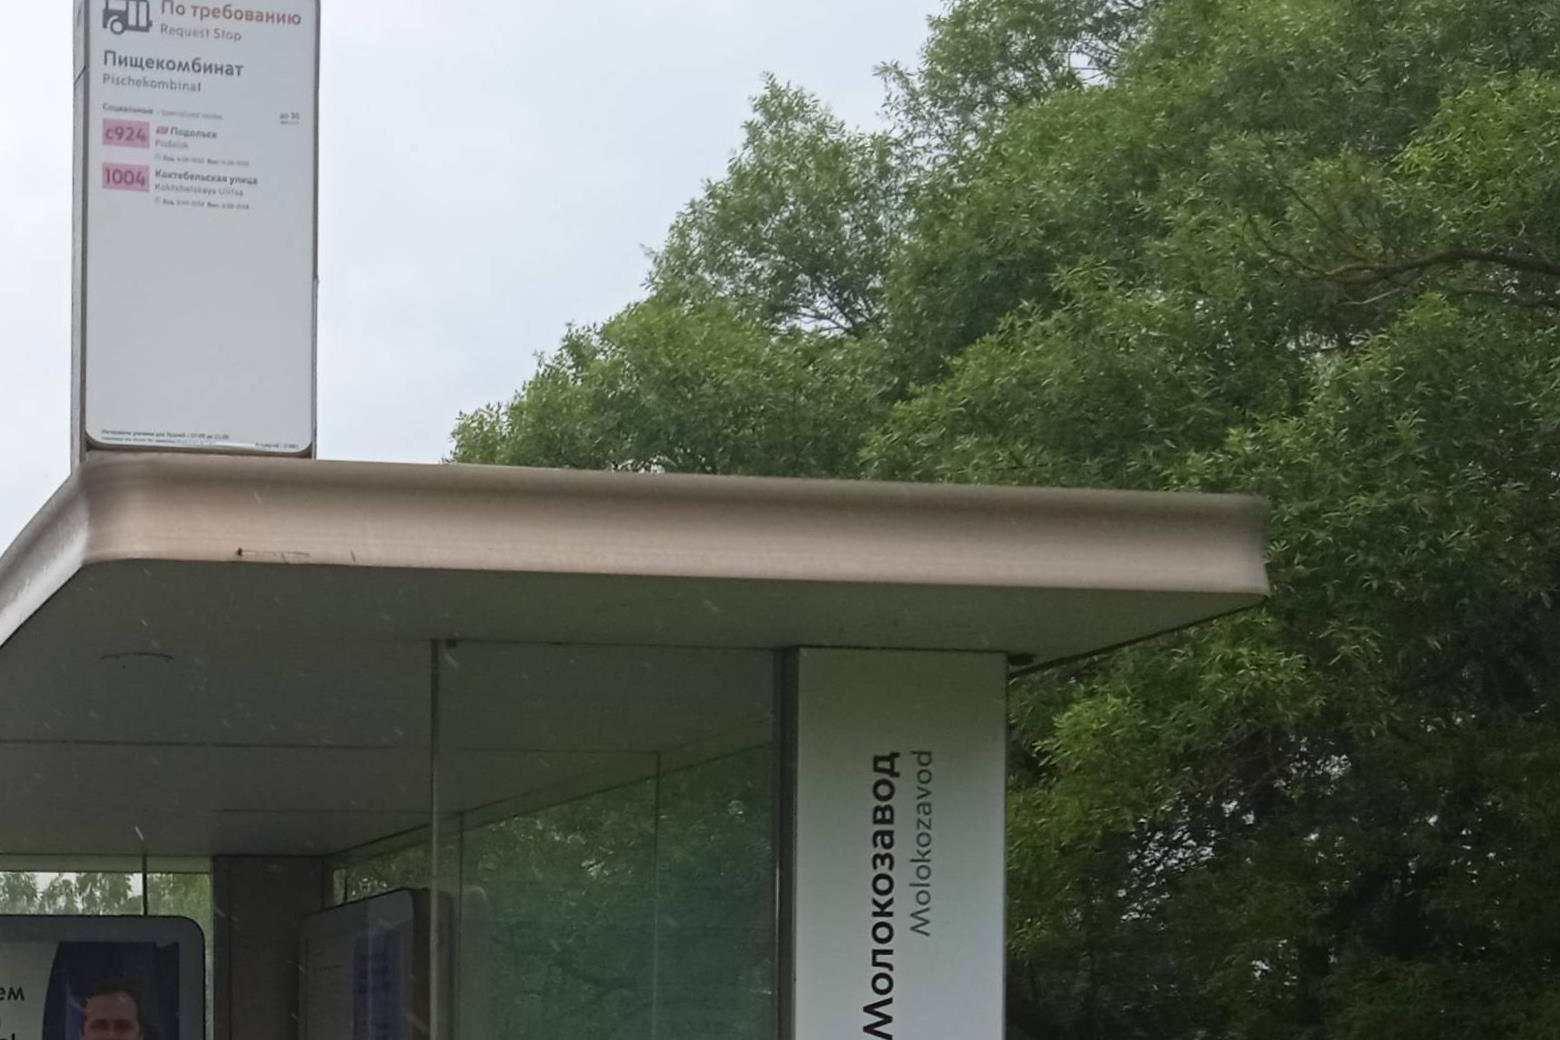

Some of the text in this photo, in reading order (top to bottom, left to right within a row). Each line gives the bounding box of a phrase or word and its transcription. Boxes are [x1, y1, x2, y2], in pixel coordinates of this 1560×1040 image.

[160, 0, 302, 26] По требованию
[160, 23, 242, 42] Request Stop
[103, 50, 244, 77] Пищекомбинат
[104, 169, 147, 187] 1004
[909, 750, 933, 937] Molokozavod
[862, 751, 901, 1040] Молокозавод
